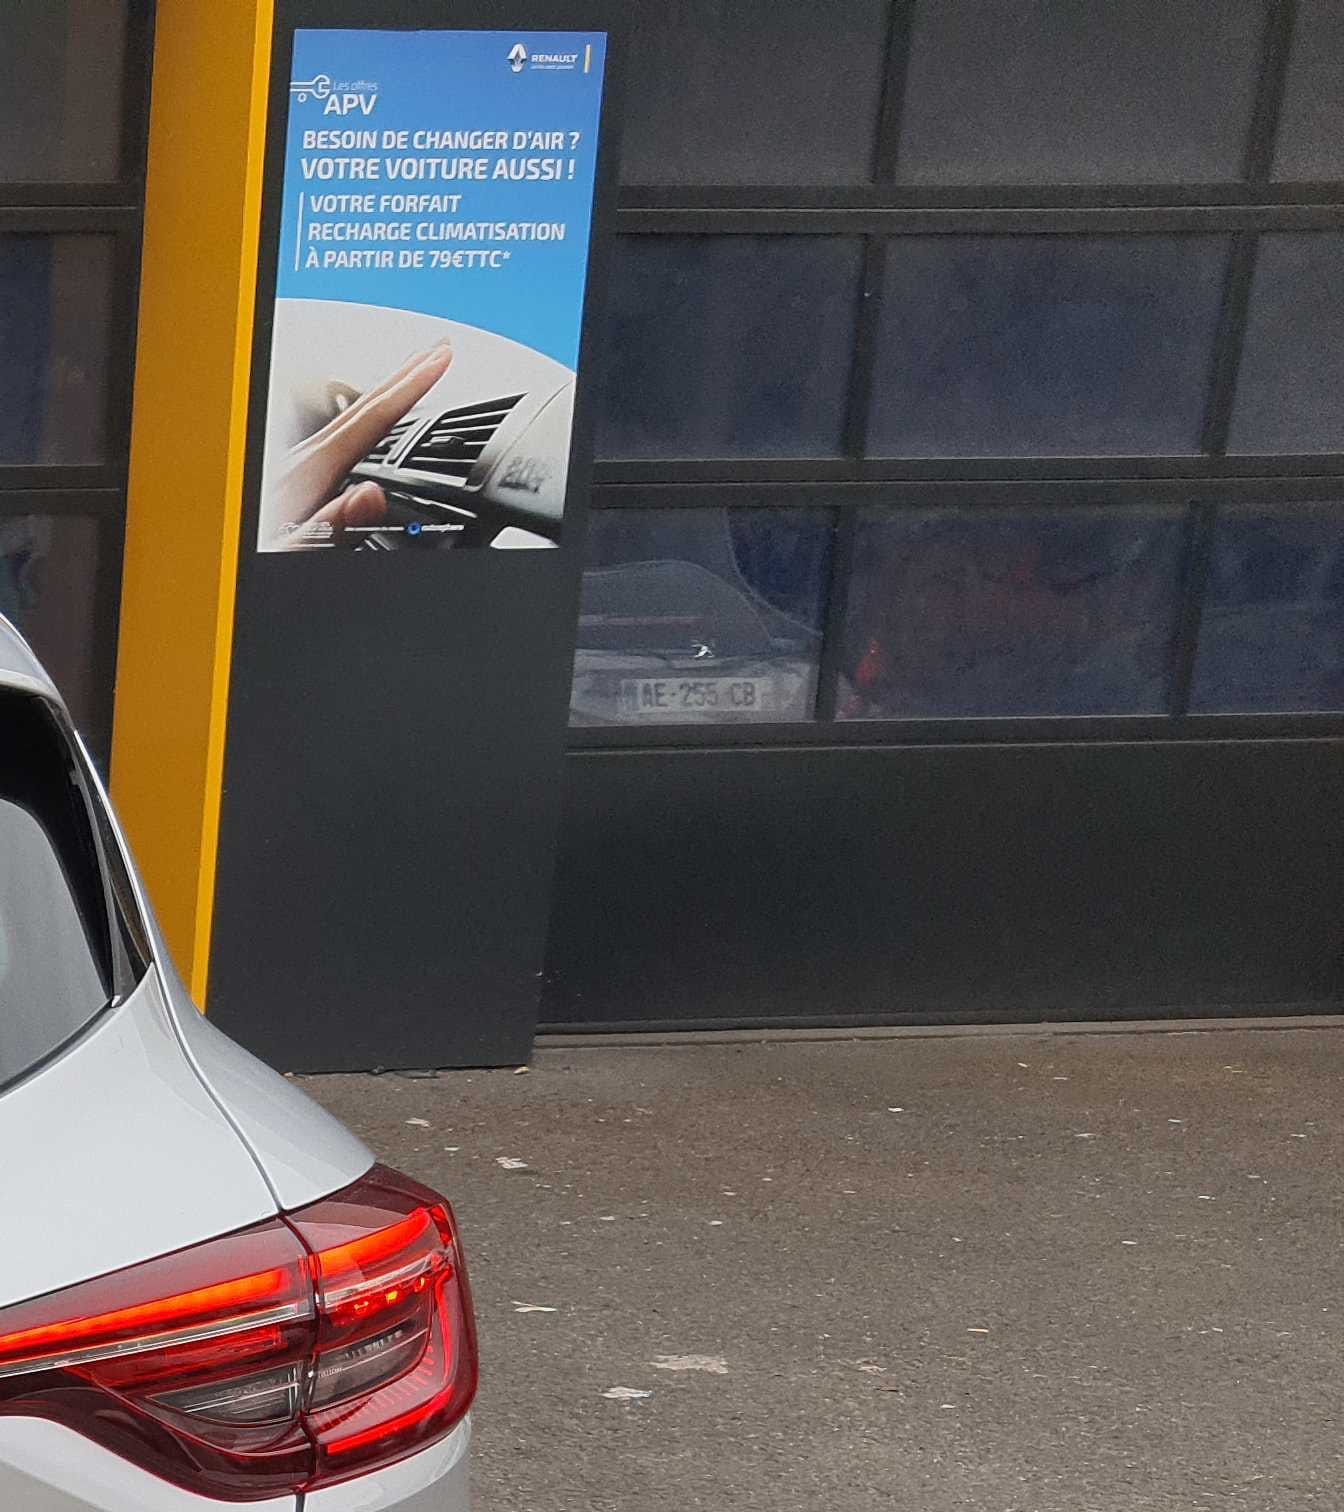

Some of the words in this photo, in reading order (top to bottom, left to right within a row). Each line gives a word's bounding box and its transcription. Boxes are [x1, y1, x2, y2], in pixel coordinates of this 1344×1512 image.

[530, 53, 578, 64] RENAULT
[323, 93, 377, 116] APV
[303, 131, 376, 150] BESOIN
[382, 131, 408, 150] DE
[412, 131, 508, 150] CHANGER
[512, 131, 563, 150] D'AIR
[300, 158, 379, 180] VOTRE
[385, 158, 488, 180] VOITURE
[492, 158, 562, 180] AUSSI
[310, 195, 375, 213] VOTRE
[379, 195, 462, 213] FORFAIT
[307, 223, 410, 241] RECHARGE
[416, 222, 566, 241] CLIMATISATION
[305, 246, 320, 269] À
[323, 250, 394, 269] PARTIR
[399, 250, 424, 269] DE
